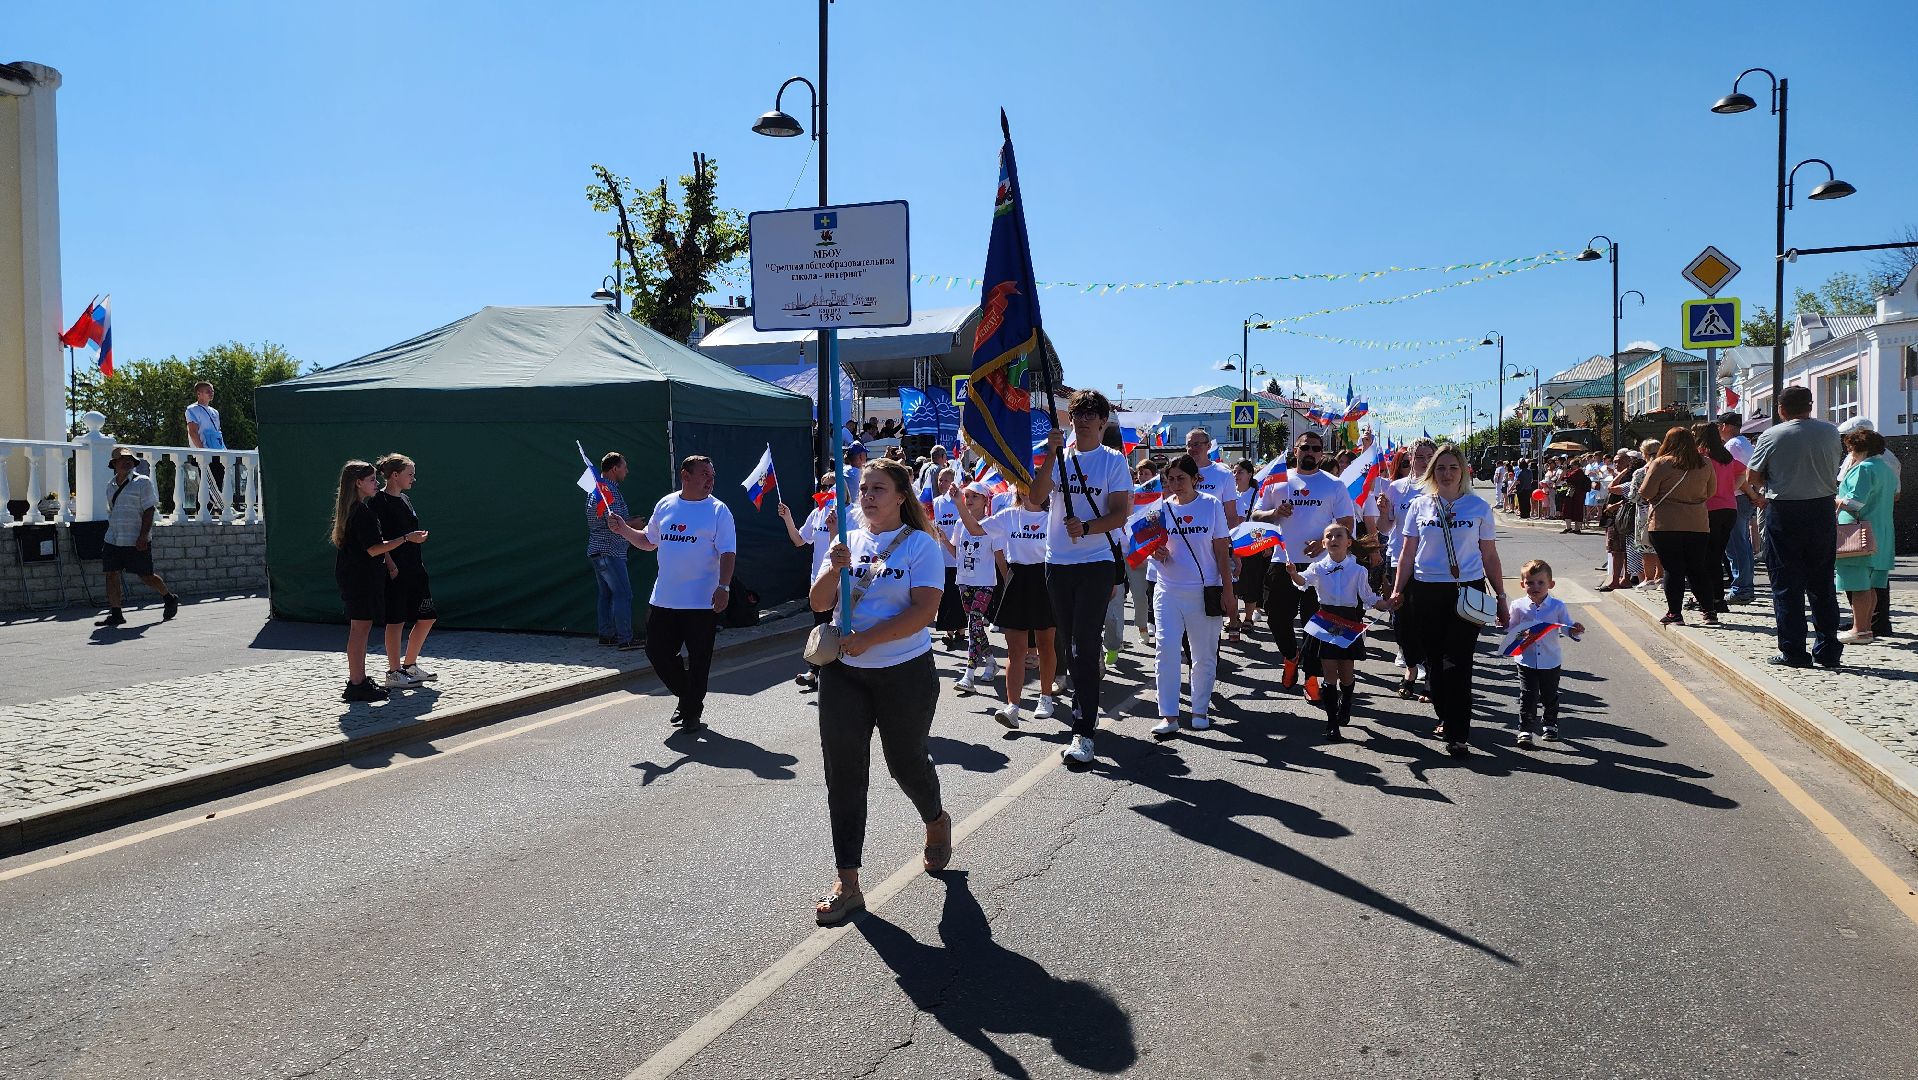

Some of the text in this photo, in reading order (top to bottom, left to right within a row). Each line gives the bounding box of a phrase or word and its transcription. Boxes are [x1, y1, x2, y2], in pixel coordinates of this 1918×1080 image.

[813, 249, 842, 259] МБОУ
[819, 313, 842, 323] 1356
[670, 523, 677, 531] Я
[1011, 531, 1047, 540] КАШИР
